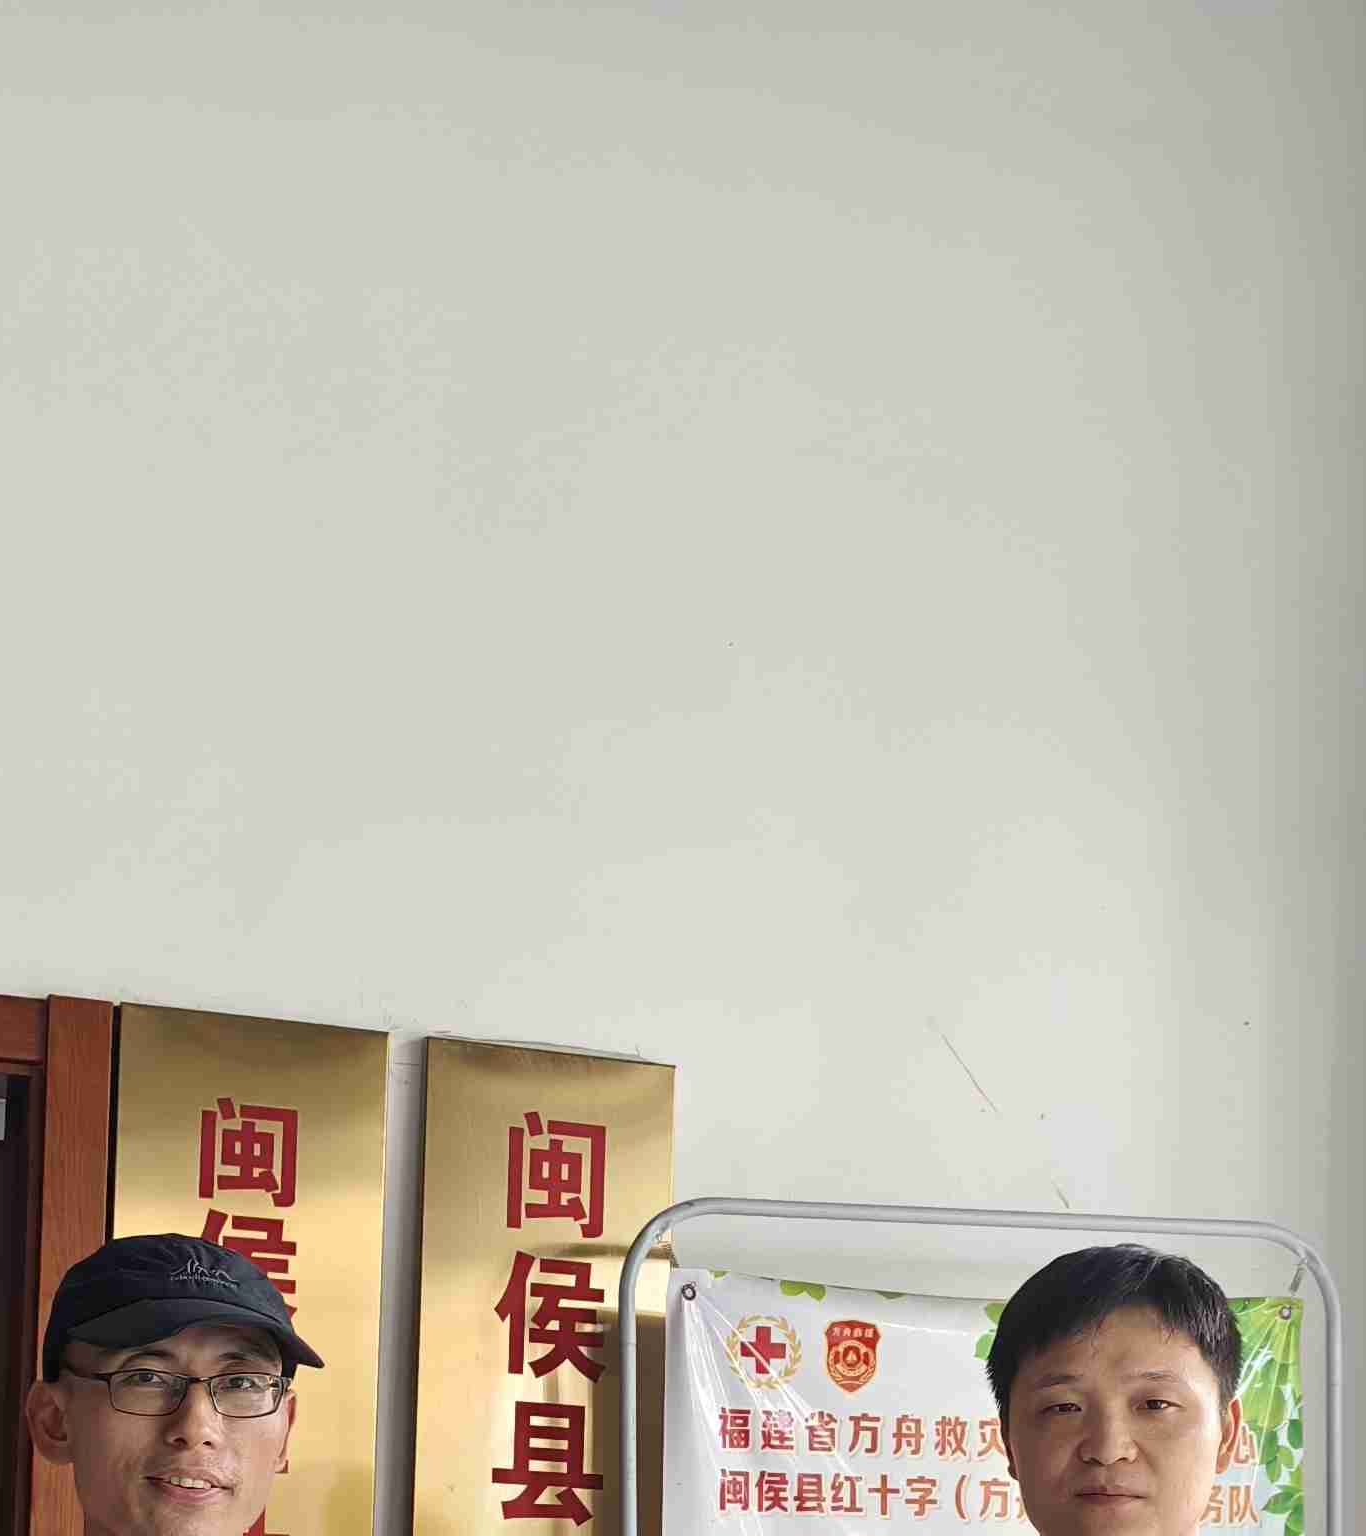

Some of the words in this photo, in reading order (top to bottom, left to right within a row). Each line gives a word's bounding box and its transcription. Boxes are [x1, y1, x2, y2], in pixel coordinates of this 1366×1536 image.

[718, 1469, 1026, 1520] 闽侯县红十字（方
